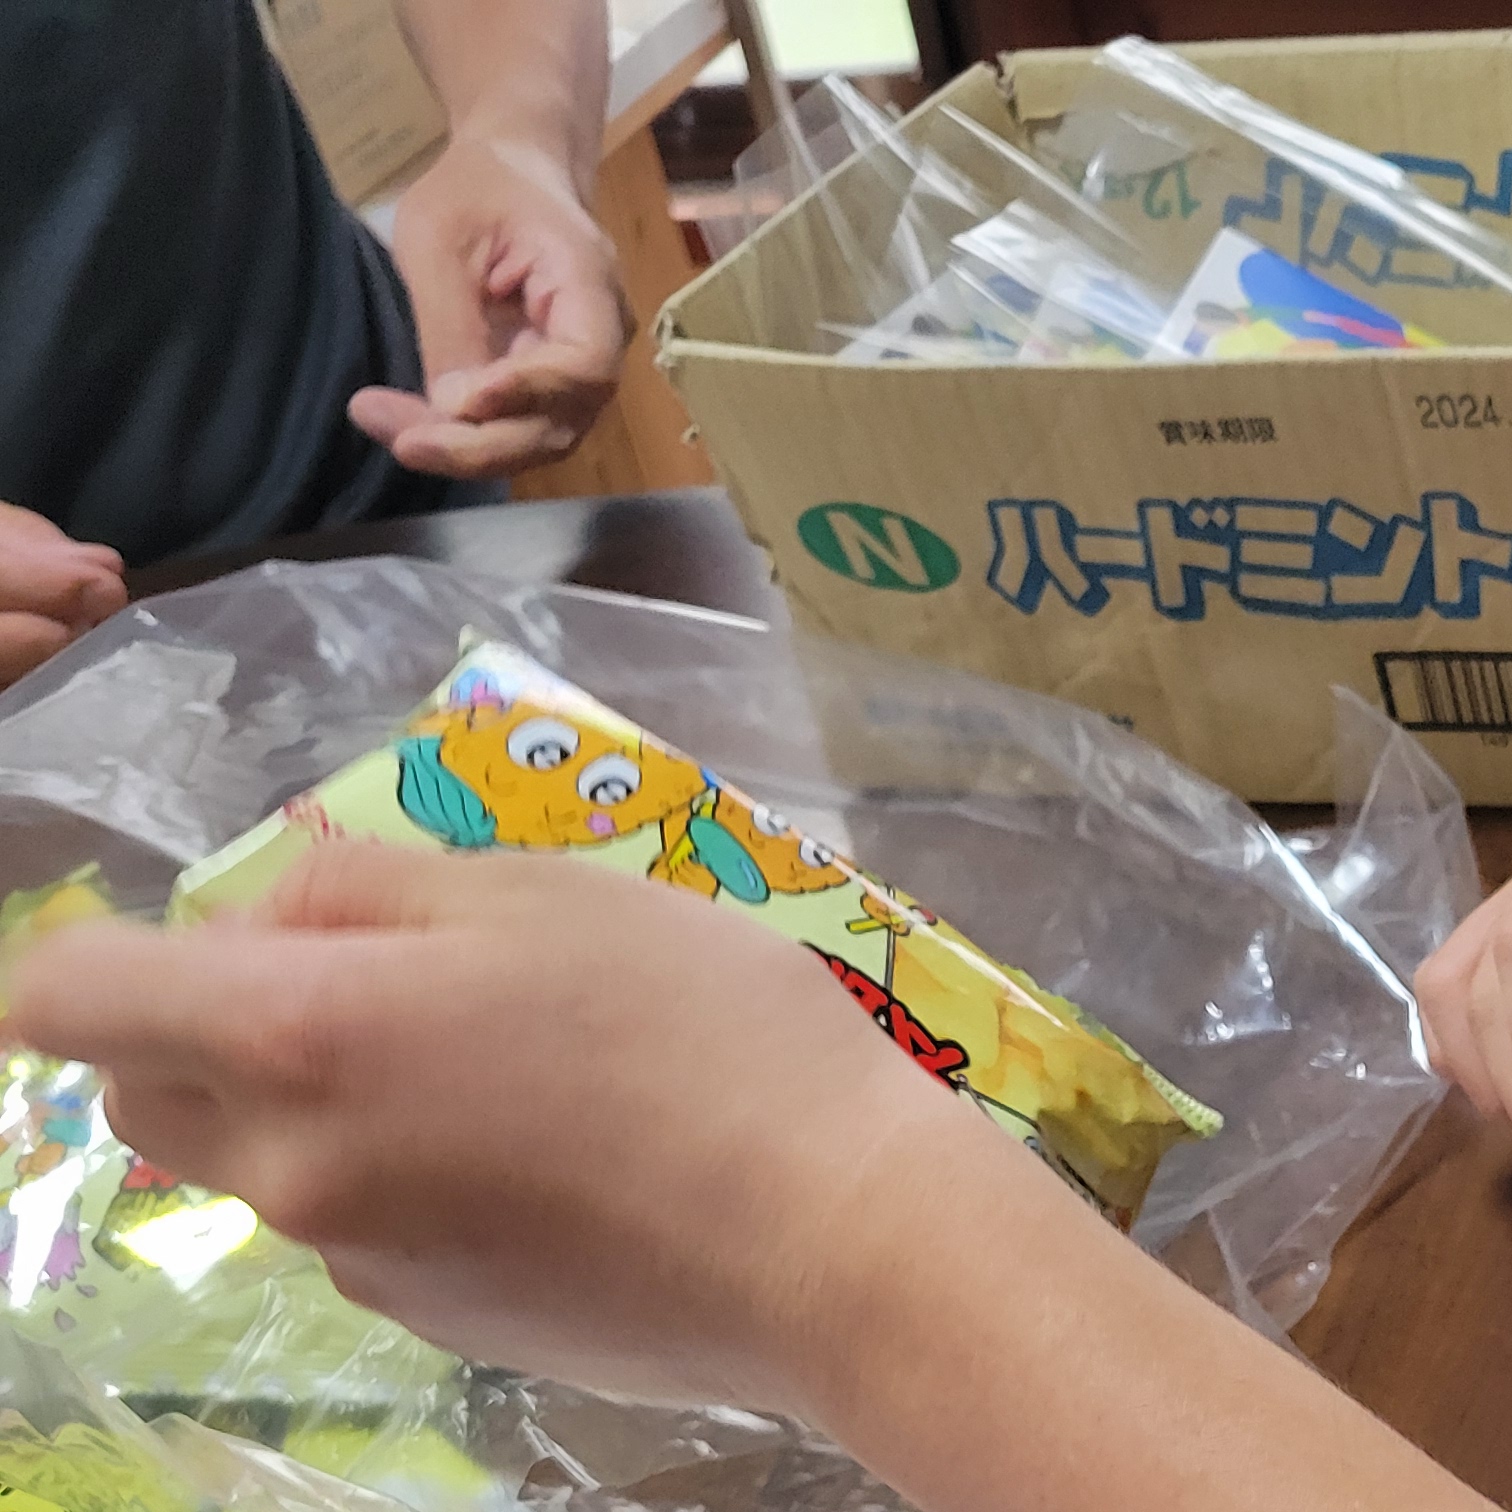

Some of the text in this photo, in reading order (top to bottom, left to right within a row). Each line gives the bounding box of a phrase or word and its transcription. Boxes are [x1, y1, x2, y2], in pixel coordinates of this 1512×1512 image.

[1157, 417, 1276, 444] 賞味期限
[832, 513, 931, 587] N
